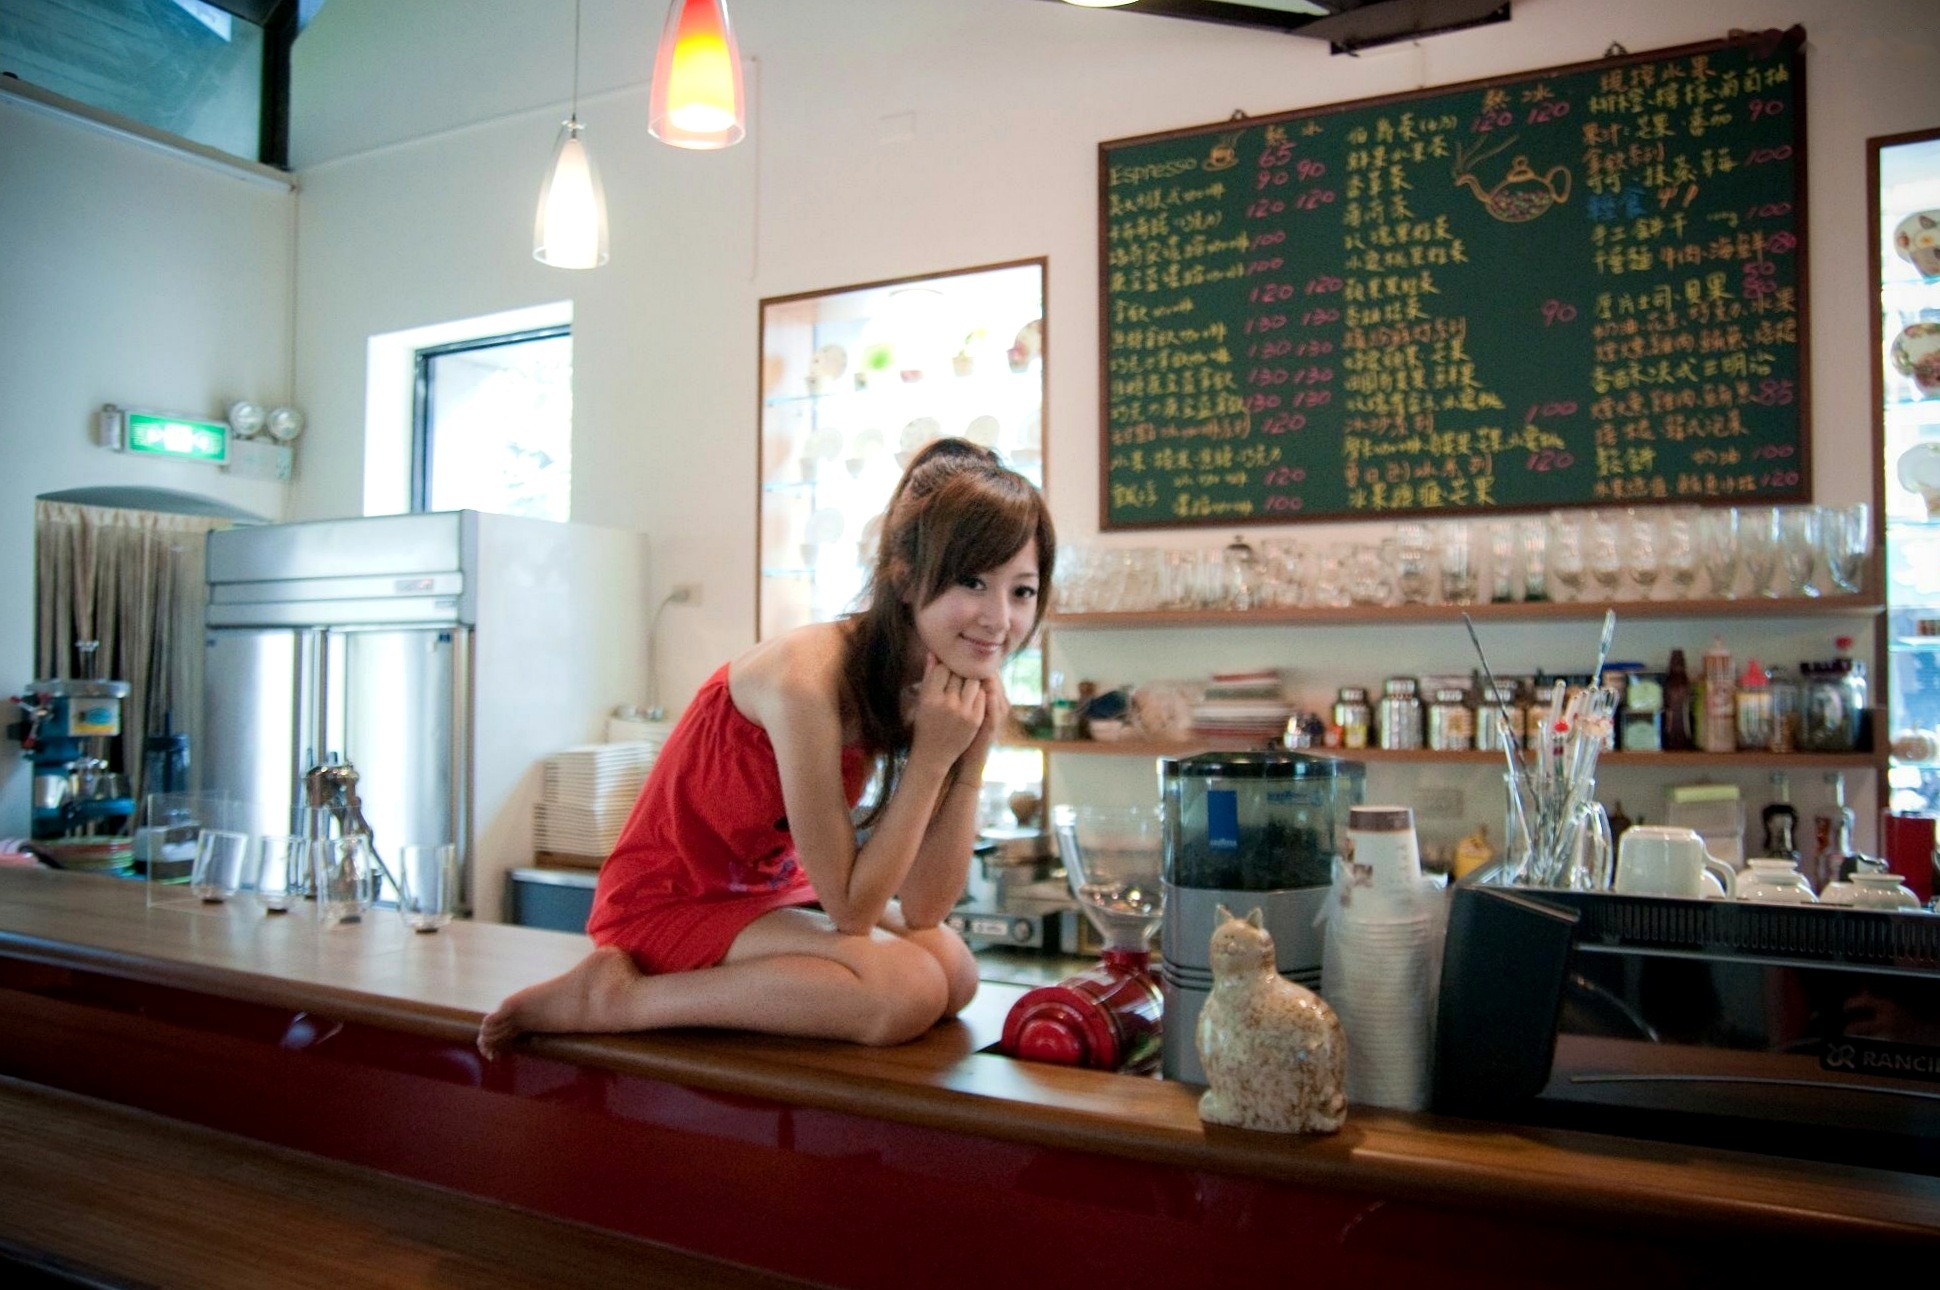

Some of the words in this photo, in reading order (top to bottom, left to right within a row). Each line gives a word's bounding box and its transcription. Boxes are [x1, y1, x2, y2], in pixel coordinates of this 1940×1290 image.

[1750, 100, 1784, 121] 90
[1745, 146, 1792, 166] 100
[1257, 170, 1288, 191] 90
[1296, 160, 1326, 181] 90
[1295, 189, 1335, 210] 120
[1748, 203, 1791, 218] 100
[1251, 230, 1286, 249] 100
[1247, 257, 1284, 275] 100
[1249, 283, 1294, 302] 120
[1305, 276, 1343, 295] 120
[1541, 300, 1577, 327] 90
[1525, 401, 1577, 423] 100
[1262, 412, 1306, 434] 120
[1526, 449, 1574, 472] 120
[1752, 444, 1794, 460] 100
[1264, 466, 1306, 486] 120
[1264, 495, 1303, 510] 100
